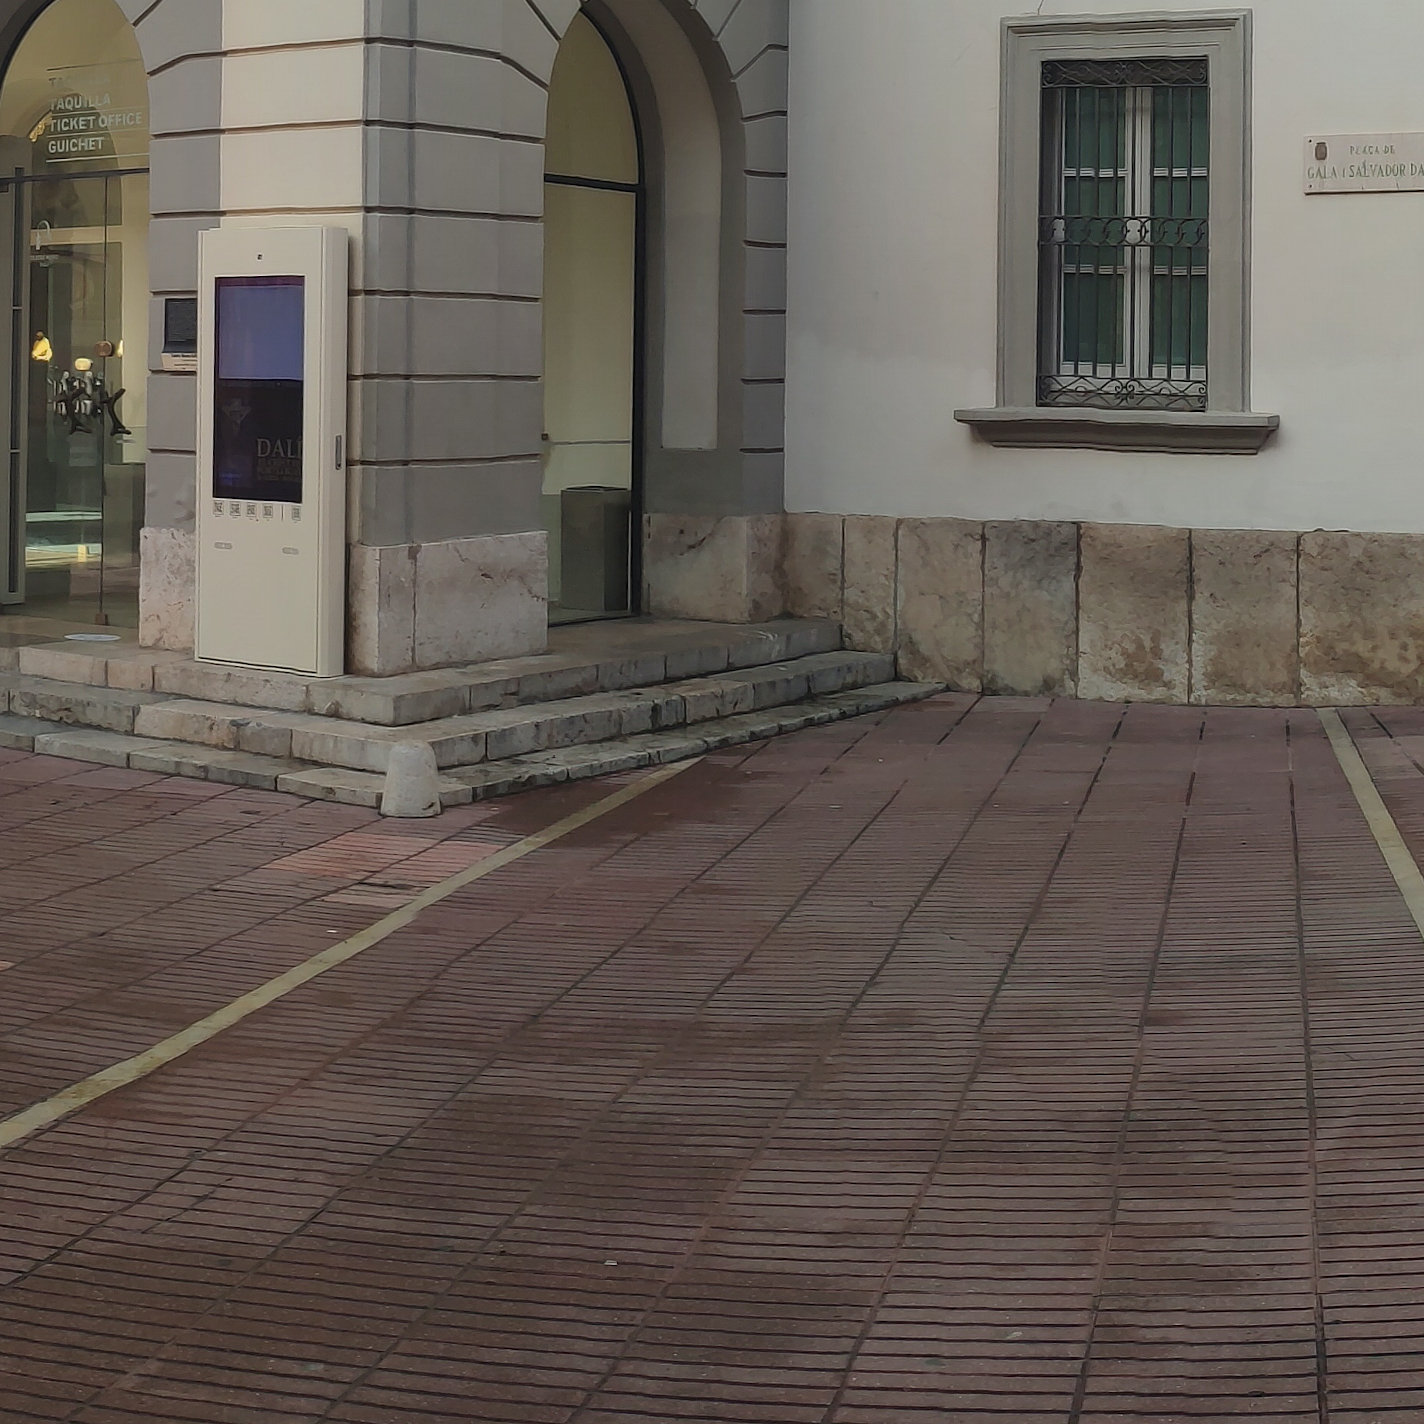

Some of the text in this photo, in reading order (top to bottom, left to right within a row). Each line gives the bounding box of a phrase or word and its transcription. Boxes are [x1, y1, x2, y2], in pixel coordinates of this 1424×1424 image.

[49, 93, 111, 110] TAQUILLA
[49, 112, 143, 132] TICKET OFFICE
[48, 137, 105, 153] GUICHET
[1383, 144, 1396, 155] DE
[1307, 164, 1338, 180] GALA
[1349, 159, 1406, 178] SALVADOR
